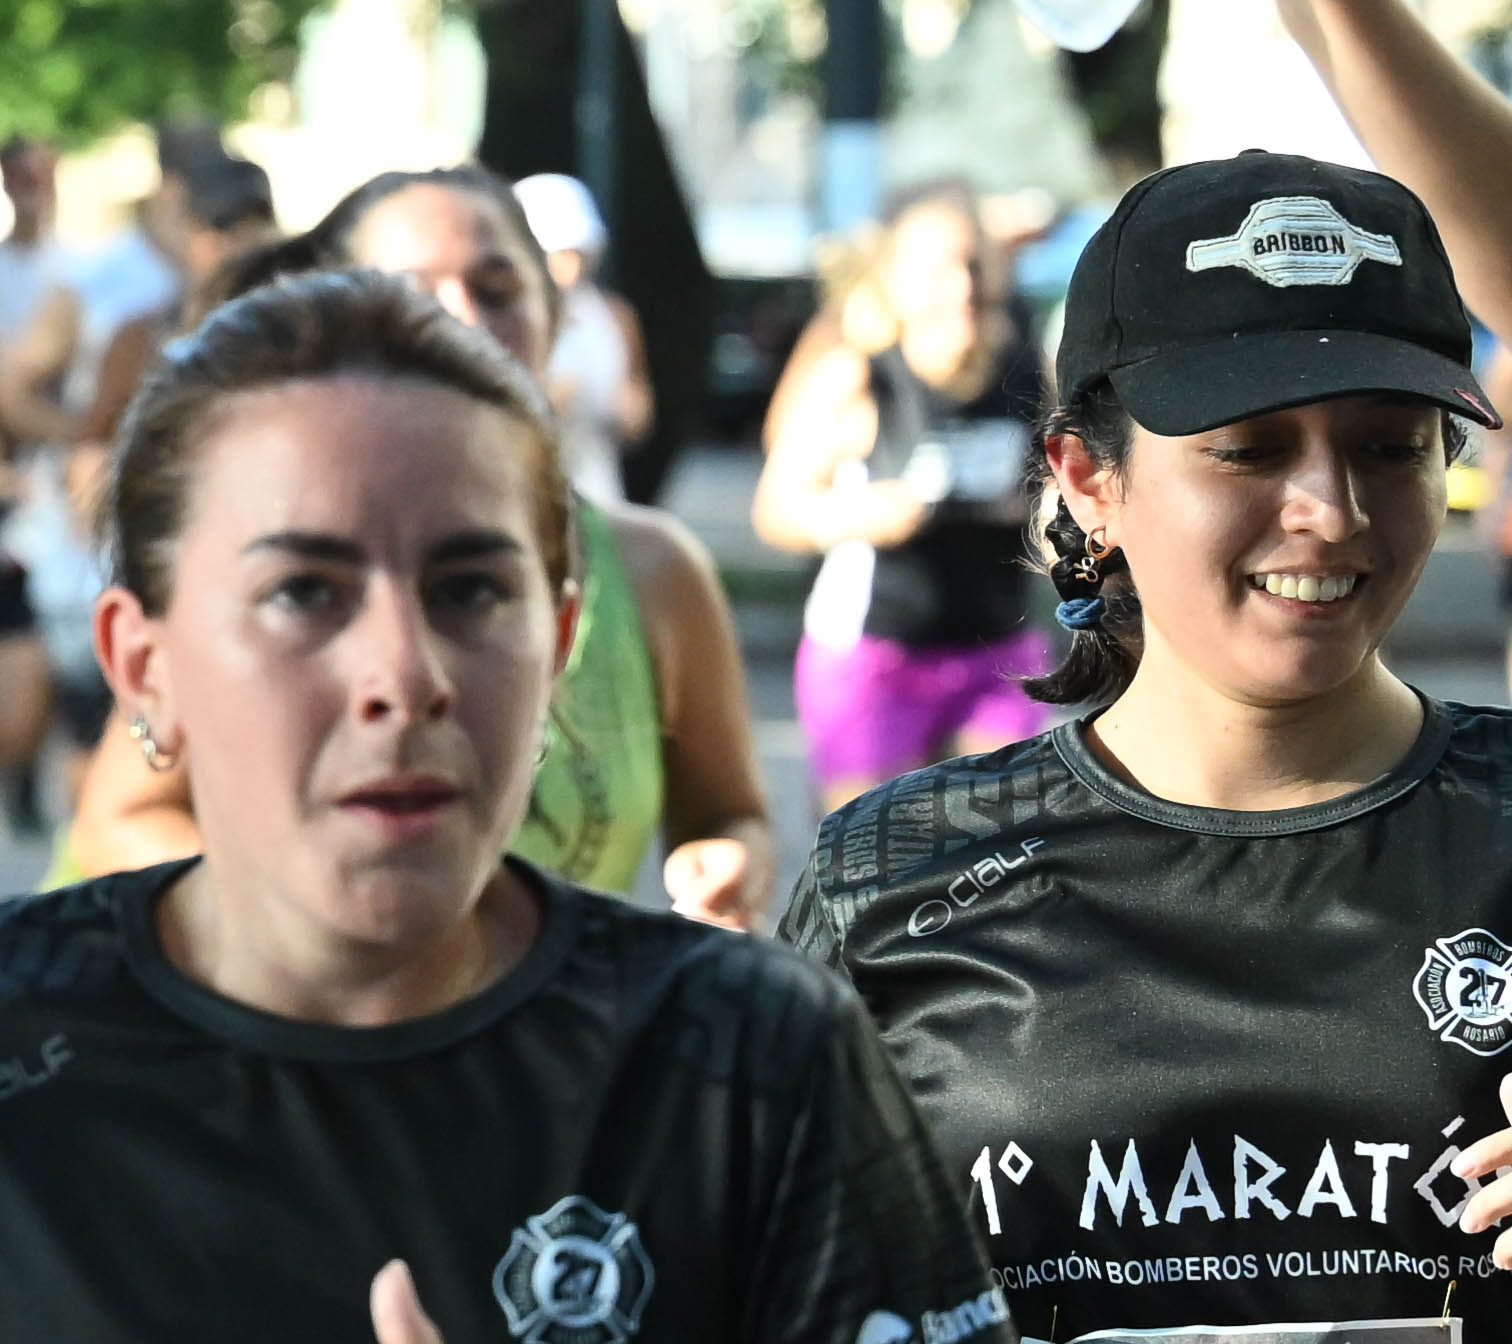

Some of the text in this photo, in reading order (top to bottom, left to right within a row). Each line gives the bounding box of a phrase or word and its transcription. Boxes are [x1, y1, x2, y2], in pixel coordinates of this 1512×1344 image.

[1454, 941, 1505, 962] BOMBEROS
[1459, 966, 1507, 1008] 27
[1463, 1025, 1506, 1043] ROSARIO
[1079, 1115, 1506, 1231] MARATÓ
[552, 1251, 604, 1301] 27
[990, 1251, 1102, 1289] OCIACIÓN
[1105, 1255, 1258, 1285] BOMBEROS
[1265, 1250, 1450, 1280] VOLUNTARIOS
